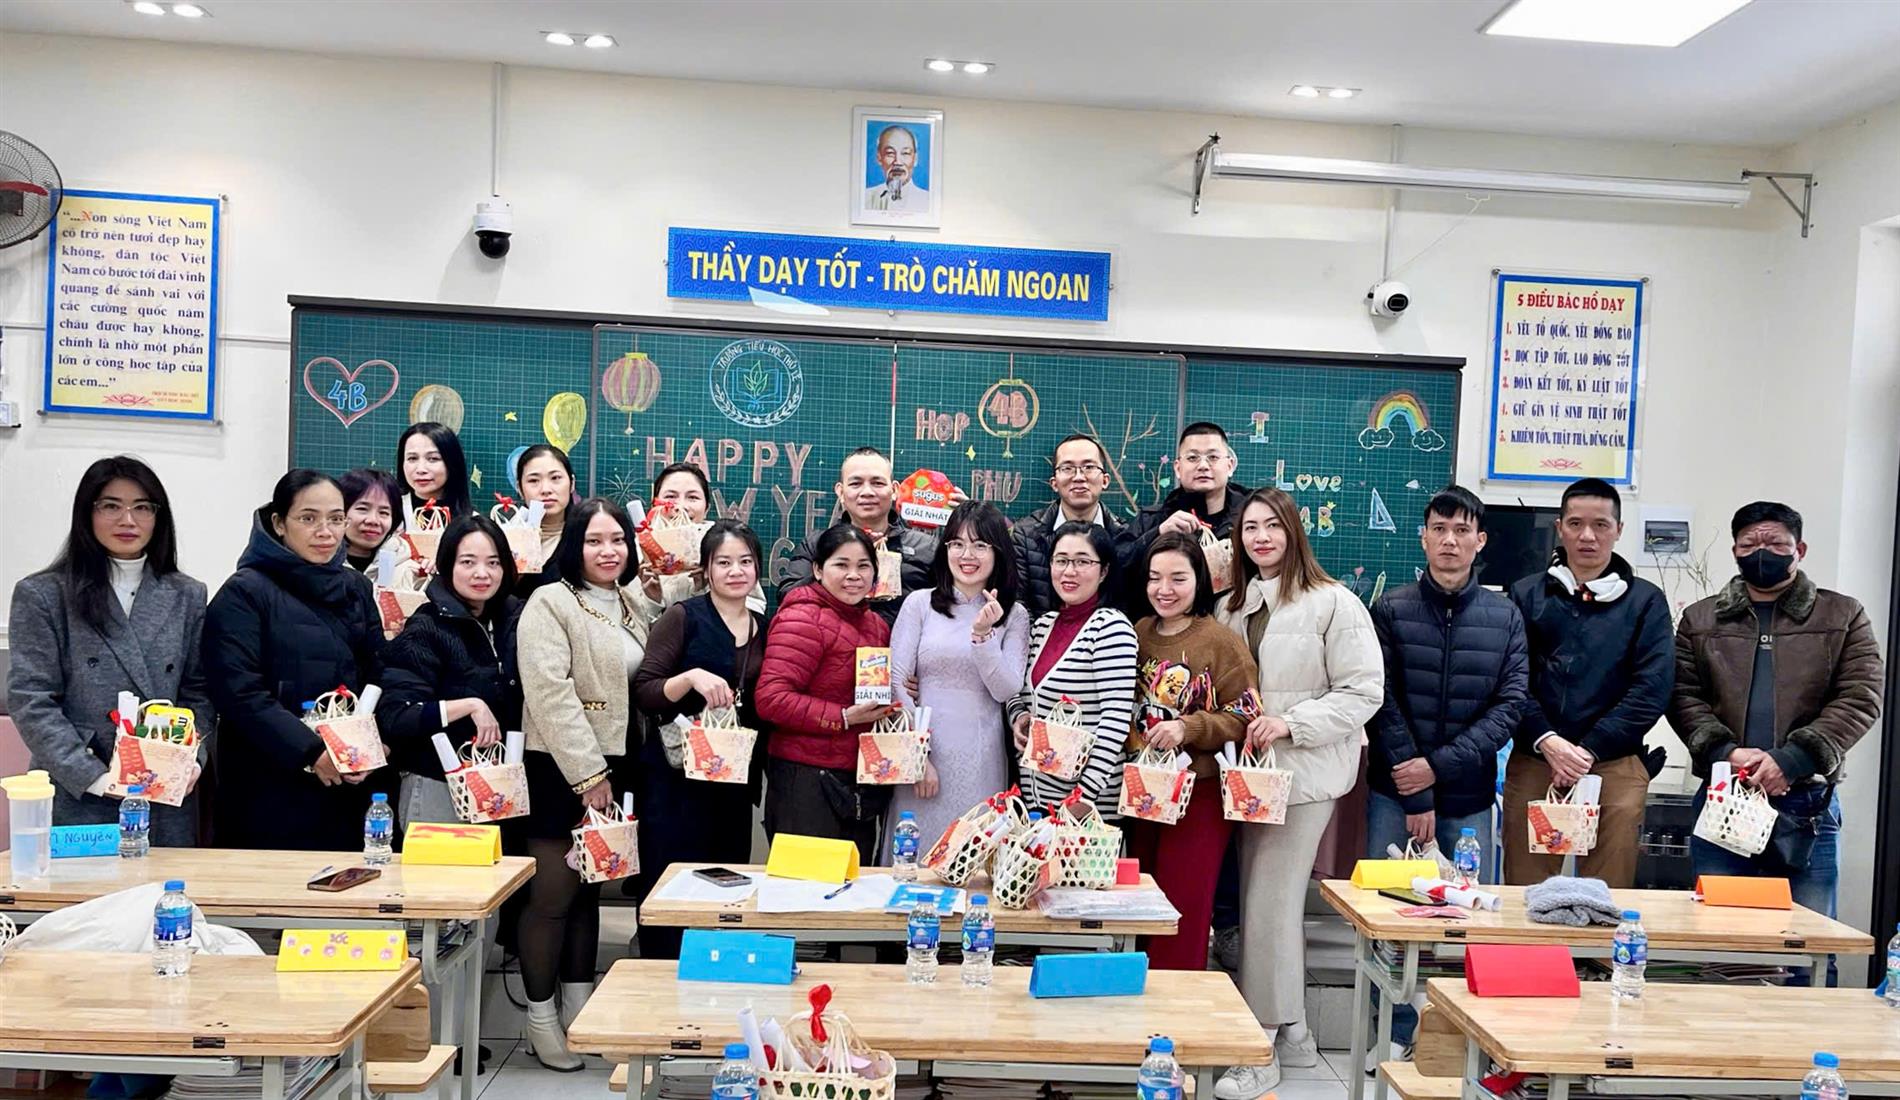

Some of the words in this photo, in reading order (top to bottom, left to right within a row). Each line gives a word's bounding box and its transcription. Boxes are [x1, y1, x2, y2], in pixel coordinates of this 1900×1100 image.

[148, 215, 171, 228] Việt
[179, 217, 207, 229] Nam
[62, 227, 76, 238] có
[158, 233, 180, 246] đẹp
[184, 235, 206, 248] hay
[181, 253, 205, 264] Việt
[62, 263, 90, 275] Nam
[93, 266, 106, 276] có
[109, 267, 138, 279] bước
[140, 269, 155, 279] tới
[180, 272, 205, 282] vinh
[688, 241, 752, 282] THẦY
[758, 255, 810, 294] DẠY
[815, 247, 862, 289] TỐT
[880, 256, 926, 293] TRÒ
[932, 260, 1000, 297] CHĂM
[1007, 270, 1090, 302] NGOAN
[60, 283, 99, 295] quang
[126, 287, 155, 298] sánh
[162, 289, 180, 299] vai
[187, 290, 205, 301] với
[1517, 294, 1524, 306] 5
[1527, 288, 1554, 307] ĐIỀU
[1557, 292, 1580, 309] BÁC
[1582, 290, 1598, 310] HỒ
[1601, 297, 1625, 314] DẠY
[60, 300, 80, 311] các
[90, 302, 128, 315] cường
[138, 303, 167, 317] quốc
[133, 322, 156, 336] hay
[1536, 316, 1546, 336] TỔ
[58, 337, 93, 349] chính
[99, 338, 109, 349] là
[115, 340, 139, 351] nhờ
[58, 354, 77, 365] lớn
[157, 361, 176, 373] tập
[181, 361, 203, 373] của
[1535, 347, 1549, 367] TẬP
[1574, 352, 1588, 366] LAO
[57, 375, 78, 386] các
[1615, 376, 1629, 394] TỐT
[327, 379, 368, 412] 4B
[987, 390, 1029, 428] 4B
[1565, 405, 1582, 419] SINH
[1613, 402, 1627, 421] TỐT
[1249, 411, 1270, 443] I
[646, 436, 813, 486] HAPPY
